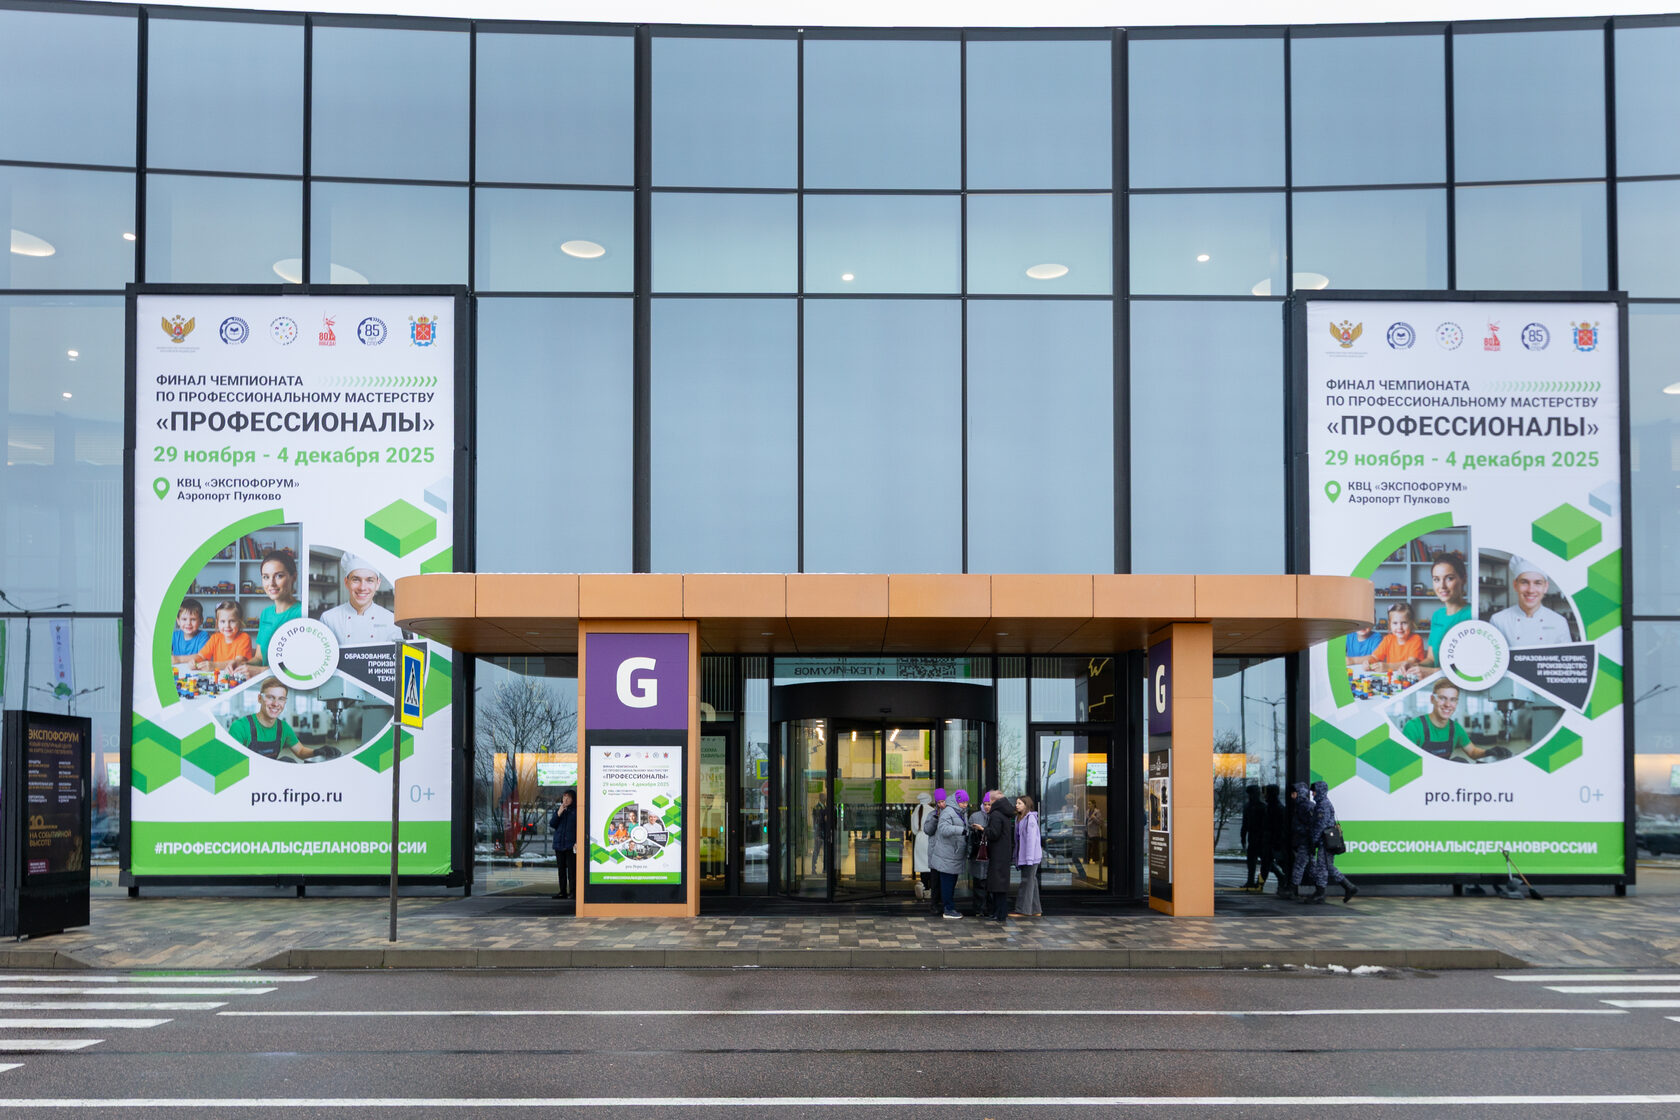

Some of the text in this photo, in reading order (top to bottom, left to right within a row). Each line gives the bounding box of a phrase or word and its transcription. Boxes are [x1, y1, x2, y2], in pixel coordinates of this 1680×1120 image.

[365, 324, 380, 337] 85
[1528, 329, 1543, 342] 85
[156, 375, 303, 386] ФИНАЛ ЧЕМПИОНАТА
[1326, 379, 1470, 391] ФИНАЛ ЧЕМПИОНАТА
[156, 392, 434, 403] ПО ПРОФЕССИОНАЛЬНОМУ МАСТЕРСТВУ
[1326, 396, 1599, 408] ПО ПРОФЕССИОНАЛЬНОМУ МАСТЕРСТВУ
[156, 411, 435, 432] «ПРОФЕССИОНАЛЫ»
[1327, 415, 1599, 437] «ПРОФЕССИОНАЛЫ»
[153, 446, 178, 463] 29
[184, 446, 256, 467] ноября
[277, 447, 289, 463] 4
[295, 447, 380, 467] декабря
[386, 447, 435, 463] 2025
[1324, 450, 1349, 466] 29
[1354, 450, 1424, 470] ноября
[1445, 451, 1457, 467] 4
[1463, 450, 1545, 471] декабря
[1551, 451, 1600, 467] 2025
[177, 478, 300, 490] КВЦ «ЭКСПОФОРУМ»
[1348, 481, 1468, 493] КВЦ «ЭКСПОФОРУМ»
[177, 491, 282, 503] Аэропорт Пулково
[1349, 494, 1450, 505] Аэропорт Пулково
[276, 626, 331, 679] 2025 ПРОФЕССИОНАЛЫ
[1447, 638, 1458, 659] 2025
[616, 656, 658, 708] G
[1155, 664, 1166, 714] G
[28, 729, 79, 743] ЭКСПОФОРУМ
[251, 788, 343, 806] pro.firpo.ru
[410, 785, 435, 803] 0+
[1425, 787, 1514, 806] pro.firpo.ru
[1579, 786, 1604, 803] 0+
